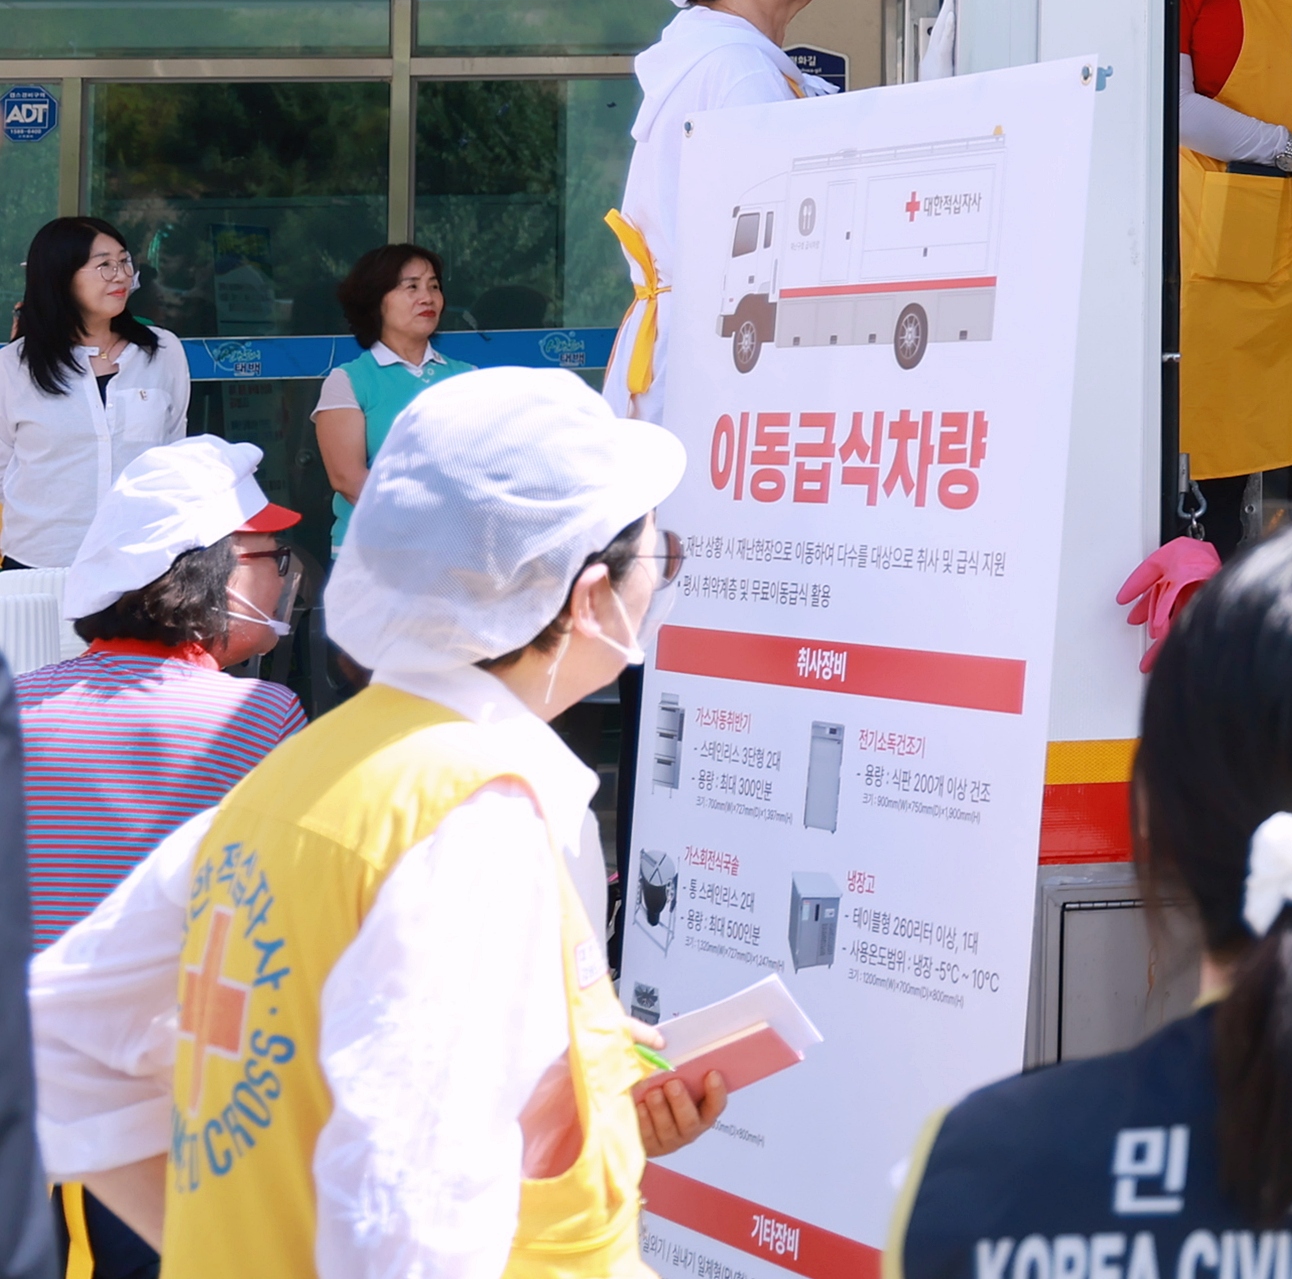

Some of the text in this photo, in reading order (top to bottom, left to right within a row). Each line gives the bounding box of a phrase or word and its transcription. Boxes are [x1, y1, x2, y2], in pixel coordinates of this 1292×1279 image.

[5, 103, 49, 124] ADT
[923, 192, 982, 217] 대한적십자사
[709, 409, 989, 511] 이동급식차량
[685, 535, 1006, 577] 재난 상황 시 재난현장으로 이동하여 다수를 대상으로 취사 및 급식 지원
[683, 574, 831, 608] 평시 취약계층 및 무료이동급식 활용
[796, 646, 848, 683] 취사장비
[695, 706, 752, 734] 가스자동취반기
[700, 740, 781, 772] 스테인리스 3단형 2대
[859, 729, 926, 759] 전기소독건조기
[698, 769, 714, 791] 용량
[720, 773, 737, 795] 최대
[738, 777, 773, 801] 300인분
[865, 764, 885, 788] 용량
[892, 768, 911, 792] 식판
[913, 772, 945, 798] 200개
[946, 777, 967, 801] 이상
[970, 780, 991, 803] 건조
[847, 870, 875, 894] 냉장고
[740, 891, 755, 914] 2대
[687, 909, 703, 932] 용량
[709, 914, 726, 937] 최대
[726, 919, 761, 946] 500인분
[853, 907, 891, 935] 테이블형
[892, 916, 934, 945] 260리터
[962, 931, 979, 955] 1대
[849, 939, 906, 973] 사용온도범위
[913, 953, 933, 979] 냉장
[203, 1028, 296, 1178] CROSS
[751, 1214, 800, 1261] 기타장비
[672, 1243, 697, 1274] 실내기
